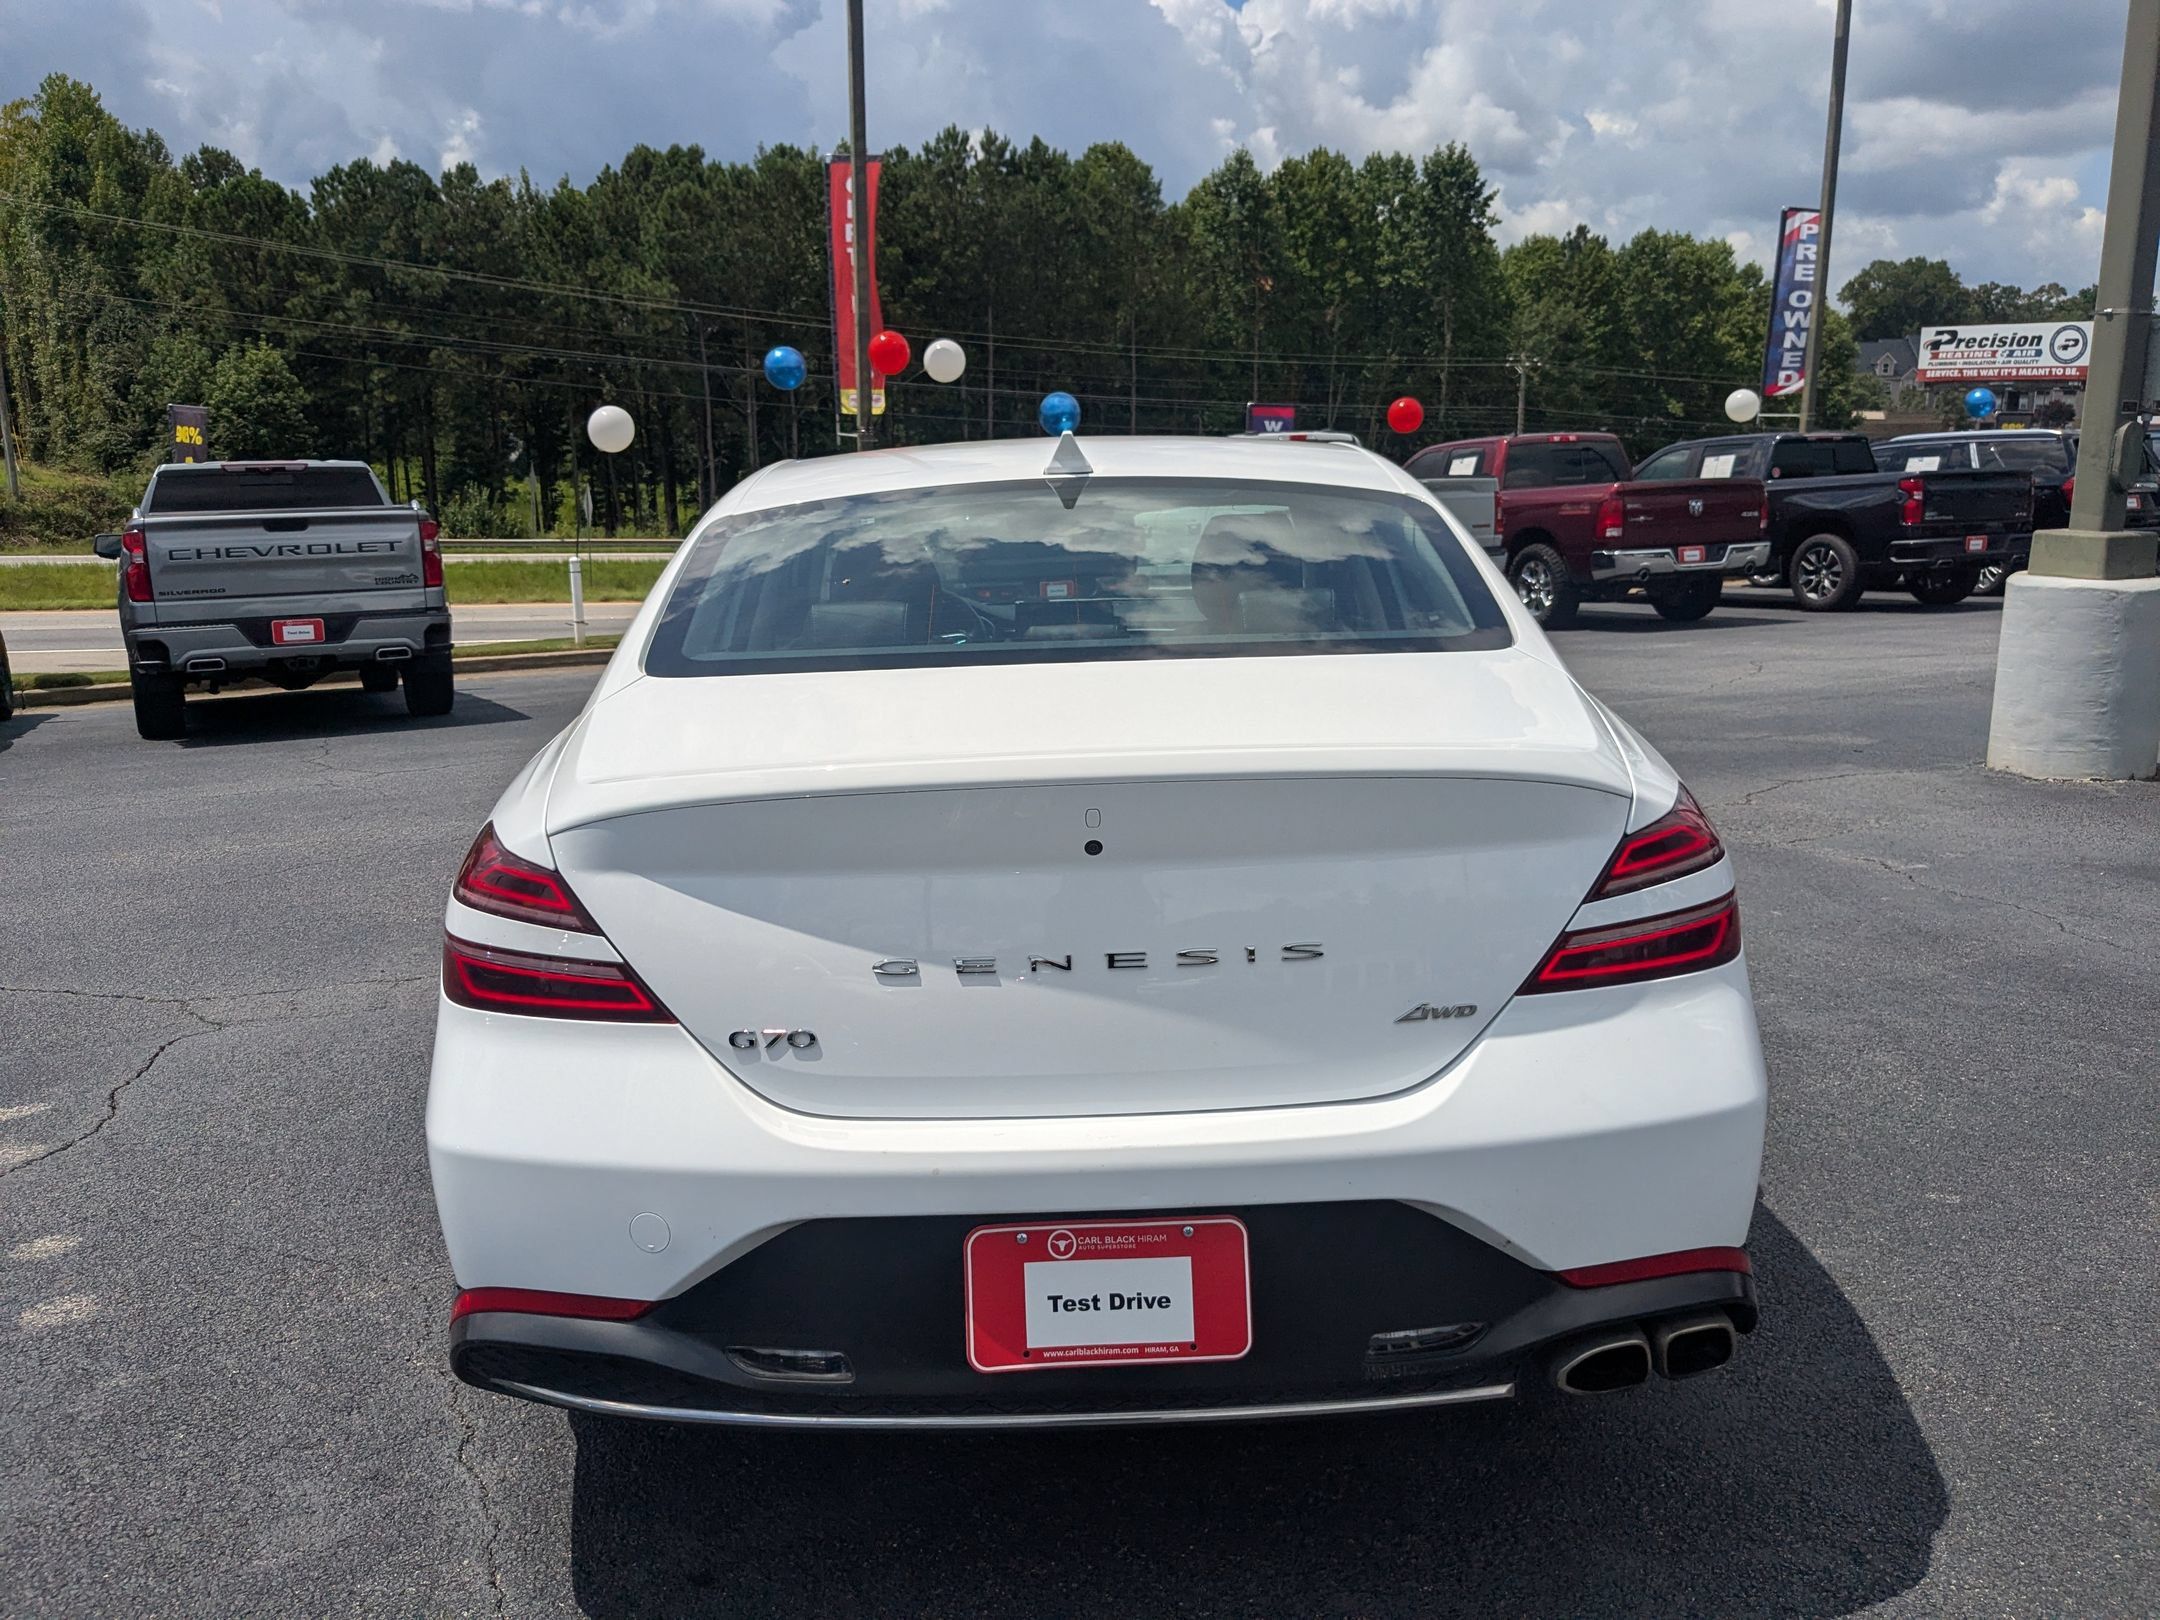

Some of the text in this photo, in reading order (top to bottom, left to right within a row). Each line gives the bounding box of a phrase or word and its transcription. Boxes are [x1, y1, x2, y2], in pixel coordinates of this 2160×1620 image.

[1777, 223, 1819, 387] PRE OWNED
[1925, 330, 2043, 350] Precision
[1938, 350, 1993, 359] HEATING
[2012, 350, 2037, 358] AIR
[2013, 358, 2041, 366] QUALITY
[1926, 367, 2080, 378] SERVICE. THE WAY IT'S MEANT TO BE.
[168, 540, 403, 562] CHEVROLET
[158, 587, 227, 597] SILVERADO
[872, 942, 1325, 976] GENESIS
[728, 1028, 816, 1049] G70
[1077, 1234, 1168, 1245] CARL BLACK HIRAM
[1047, 1291, 1172, 1313] Test Drive
[1042, 1346, 1139, 1358] www.carlblackhiram.com
[1144, 1345, 1169, 1354] HIRAM,
